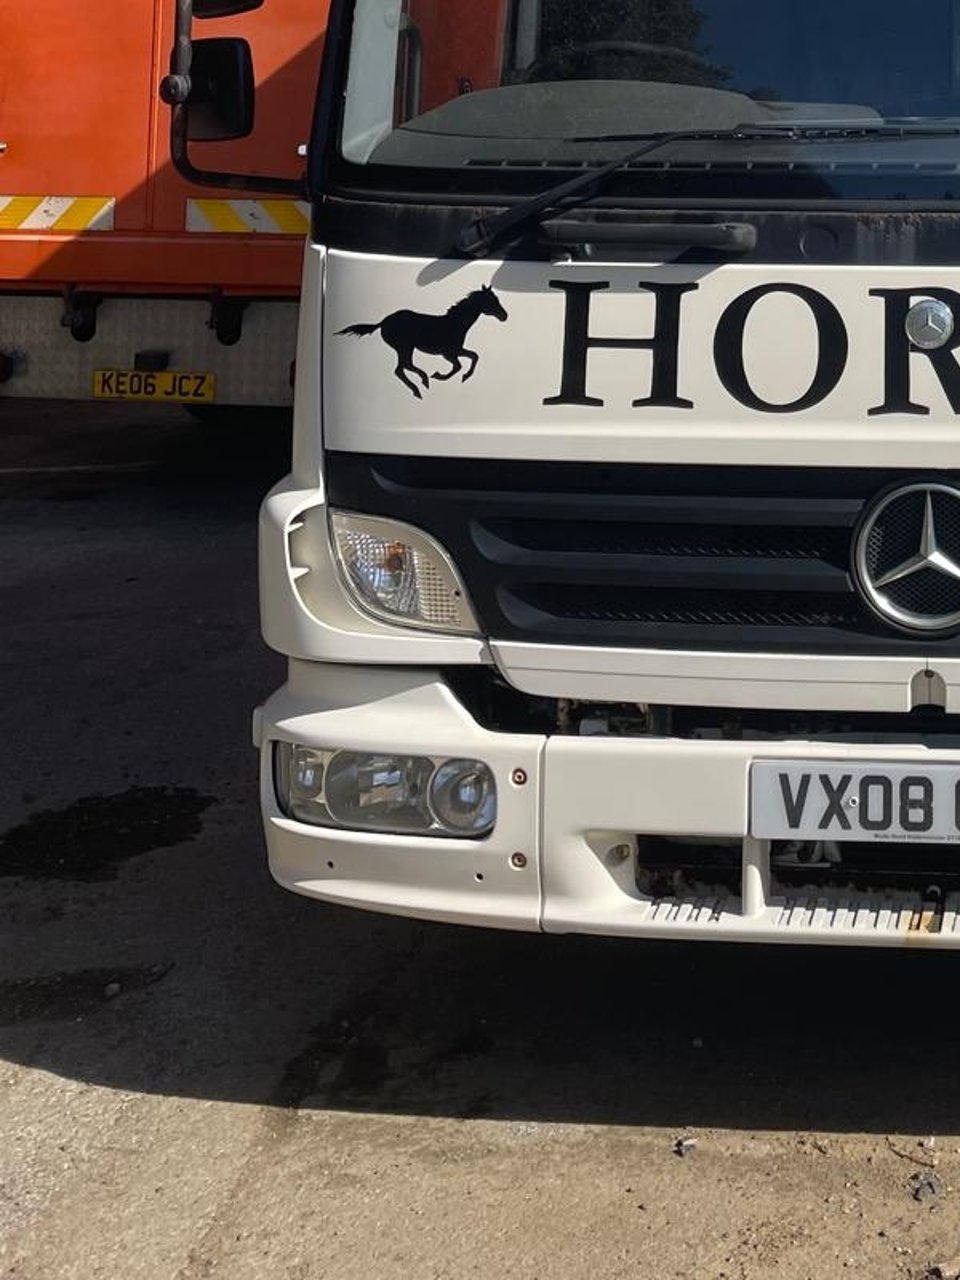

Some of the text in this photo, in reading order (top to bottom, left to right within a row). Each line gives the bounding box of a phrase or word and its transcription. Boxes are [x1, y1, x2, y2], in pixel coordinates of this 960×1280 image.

[100, 373, 207, 397] KE06 JCZ
[778, 772, 934, 832] VX08
